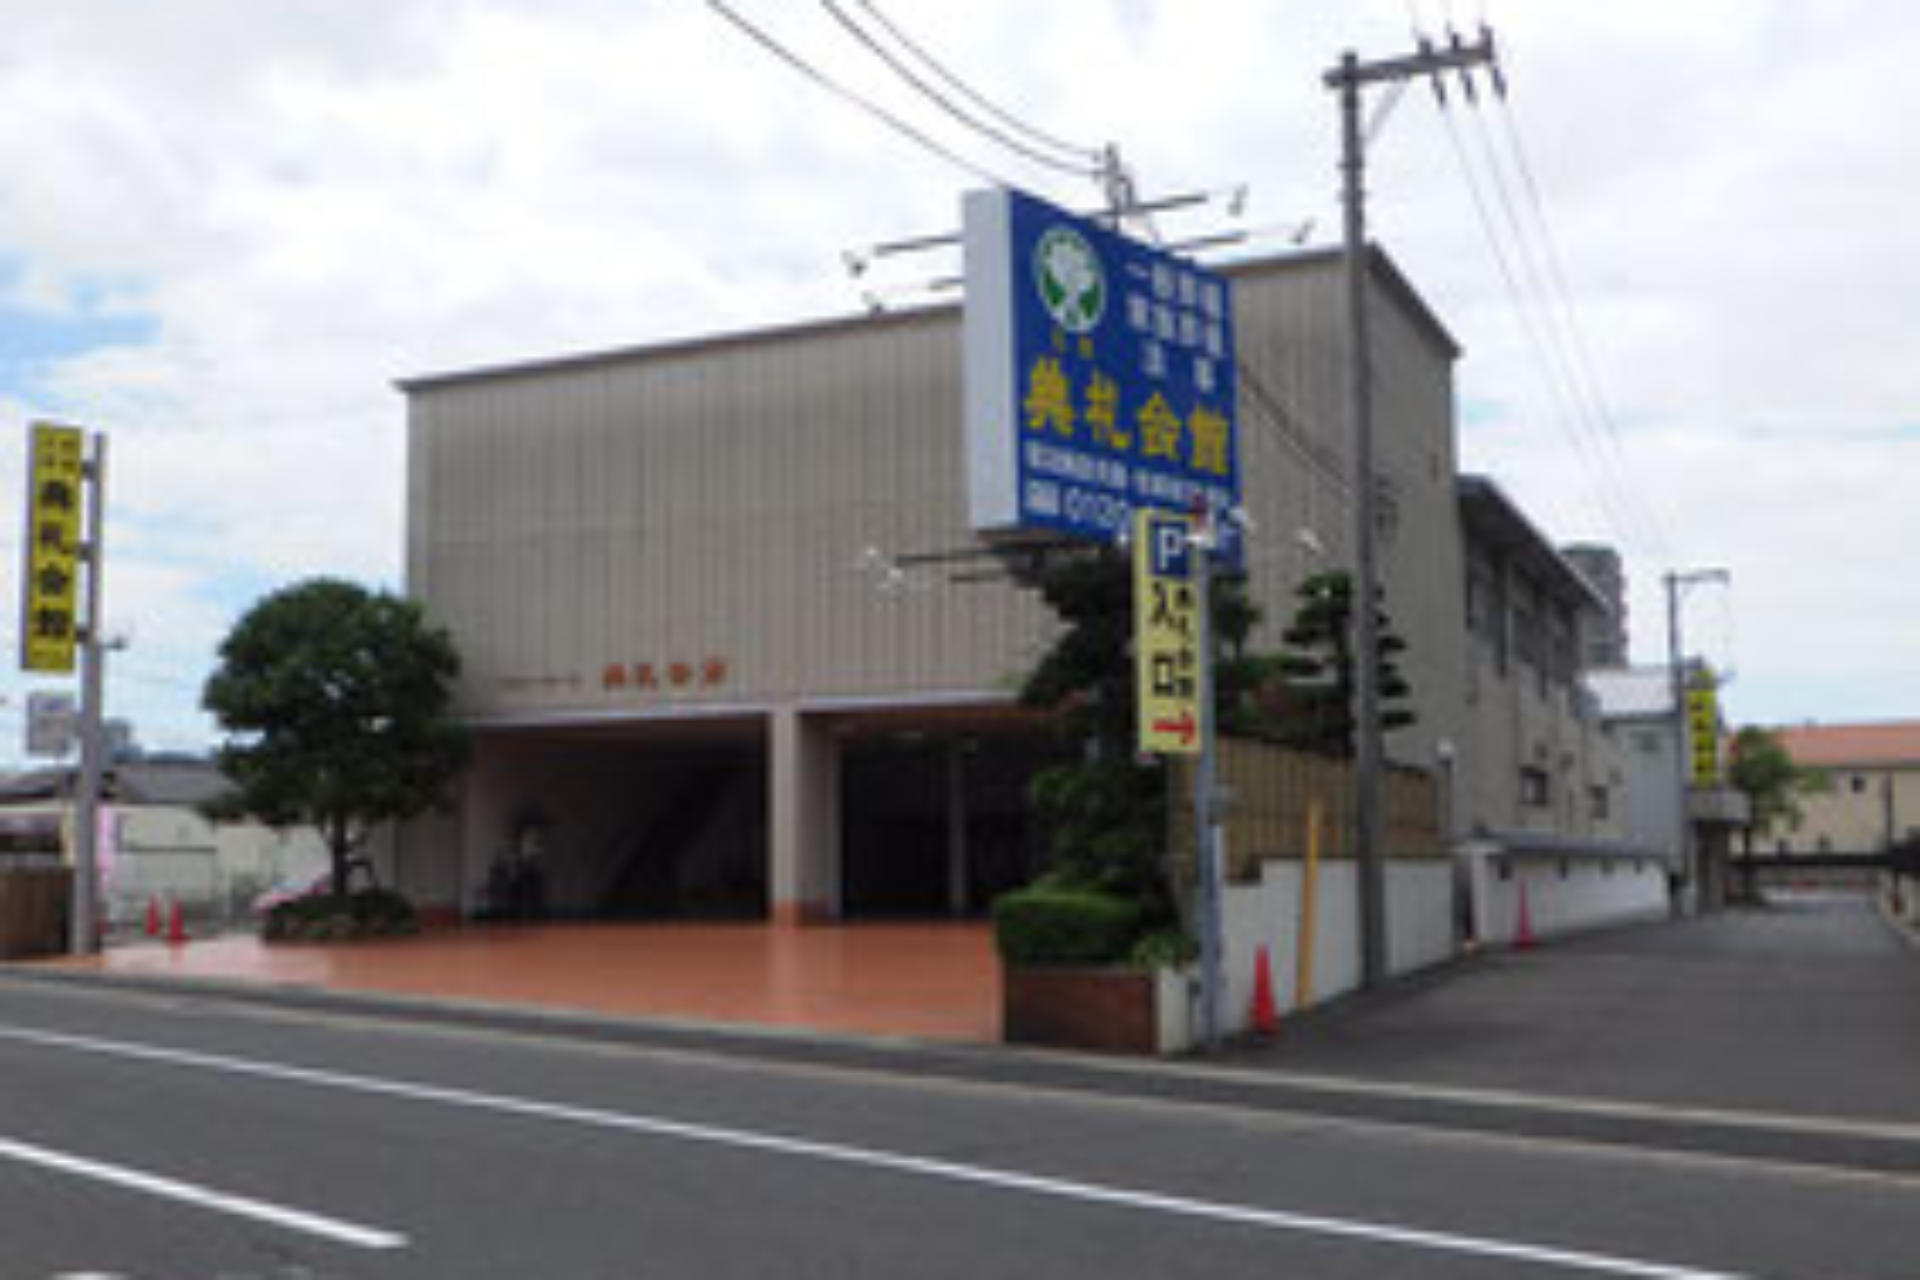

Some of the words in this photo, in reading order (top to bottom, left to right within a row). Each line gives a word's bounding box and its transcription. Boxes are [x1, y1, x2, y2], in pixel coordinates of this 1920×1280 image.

[1023, 356, 1229, 475] 典礼会館
[1159, 526, 1185, 571] P
[1151, 580, 1175, 697] 入口
